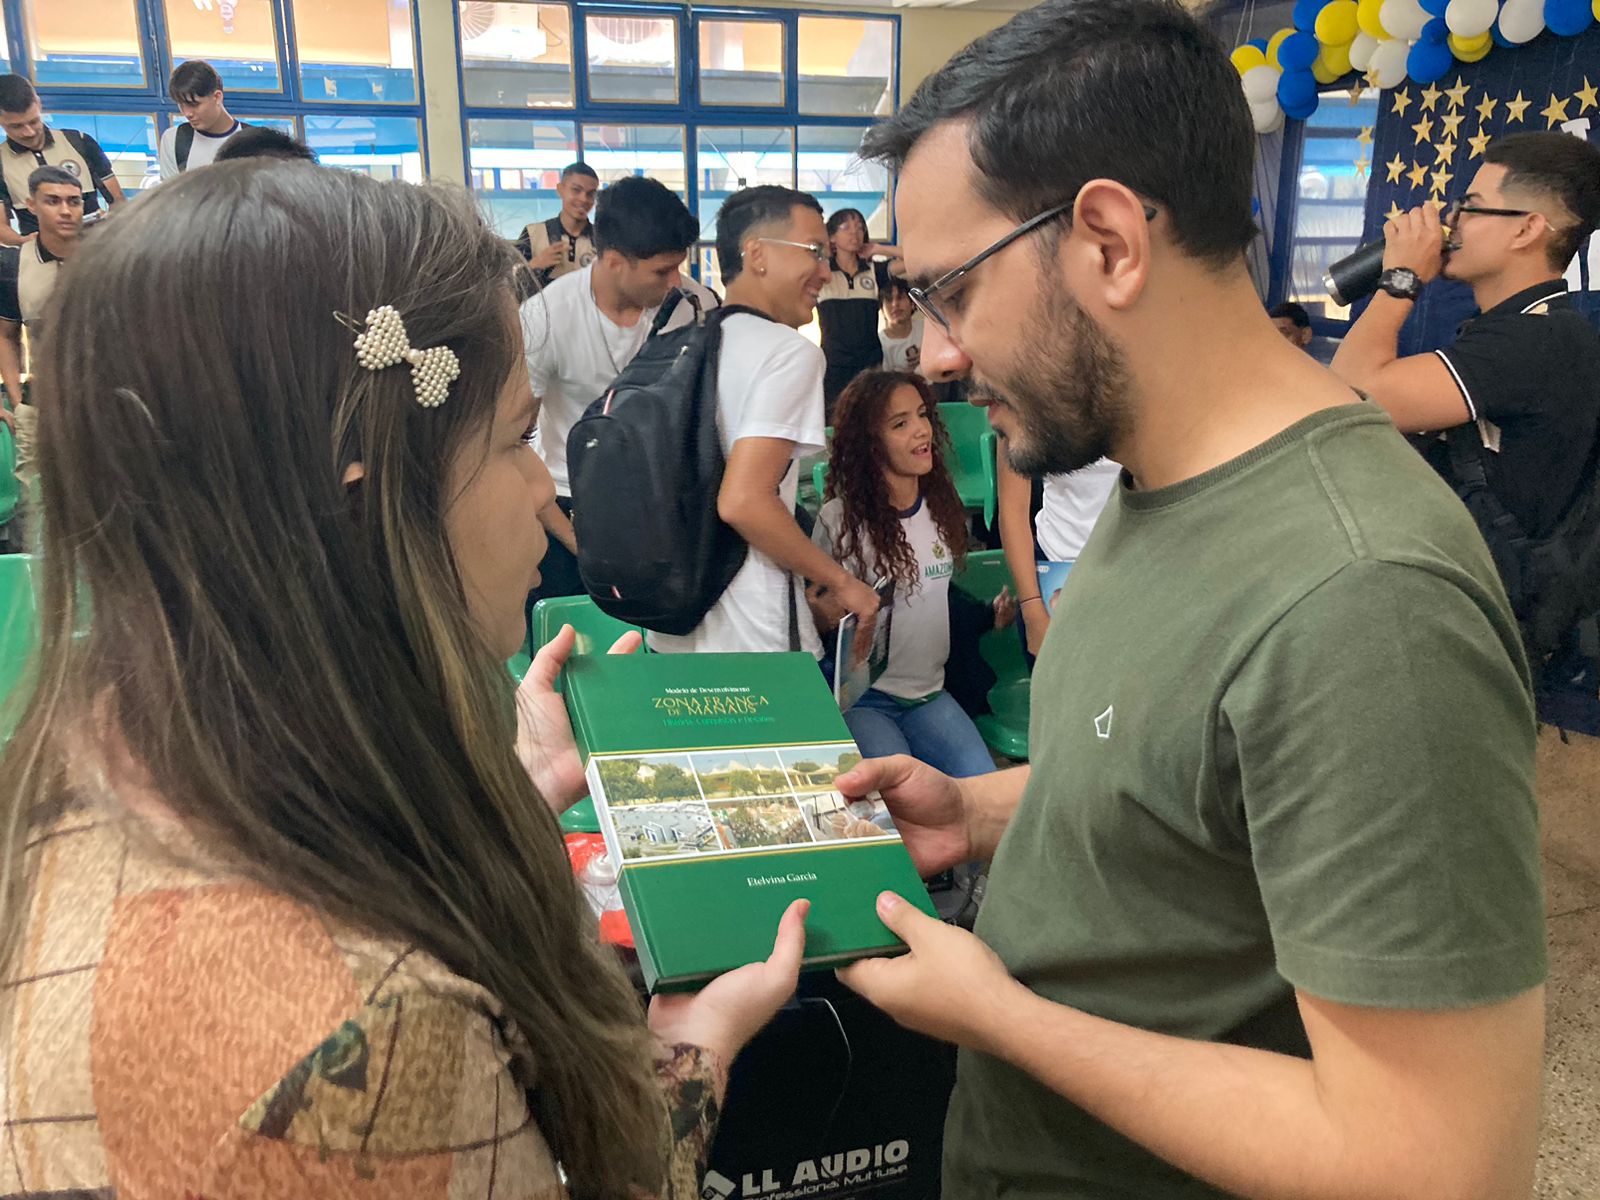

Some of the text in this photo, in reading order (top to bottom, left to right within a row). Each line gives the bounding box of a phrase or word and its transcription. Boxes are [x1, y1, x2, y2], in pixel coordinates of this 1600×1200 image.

[699, 686, 750, 694] Desenvolvimento
[651, 697, 700, 708] ZONA
[687, 703, 757, 716] MANAUS
[747, 872, 816, 887] Etelvina Garcia
[791, 1139, 909, 1186] AUDIO
